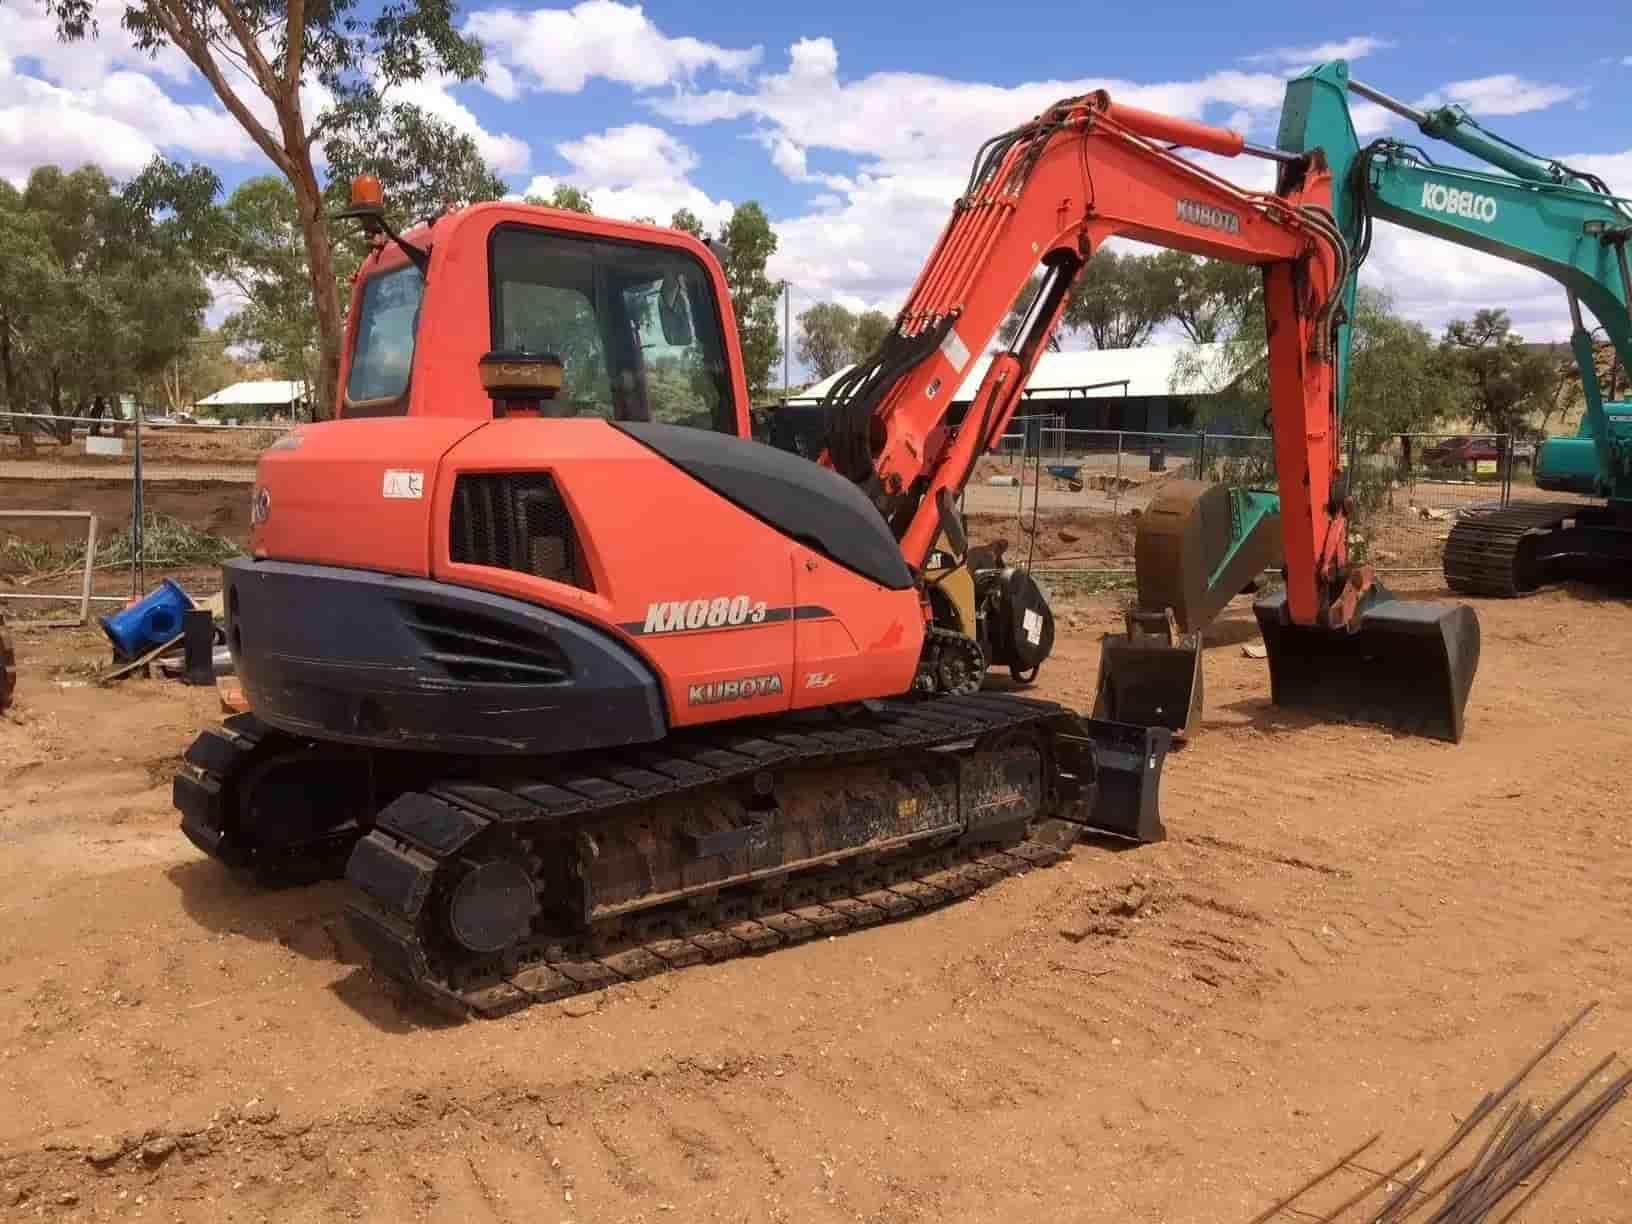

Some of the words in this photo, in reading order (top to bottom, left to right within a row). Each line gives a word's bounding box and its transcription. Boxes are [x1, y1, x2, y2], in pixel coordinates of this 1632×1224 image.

[1176, 199, 1240, 232] KUBOTA
[1421, 181, 1497, 223] KOBELCO
[643, 594, 767, 633] KX080-3
[689, 674, 783, 703] KUBOTA
